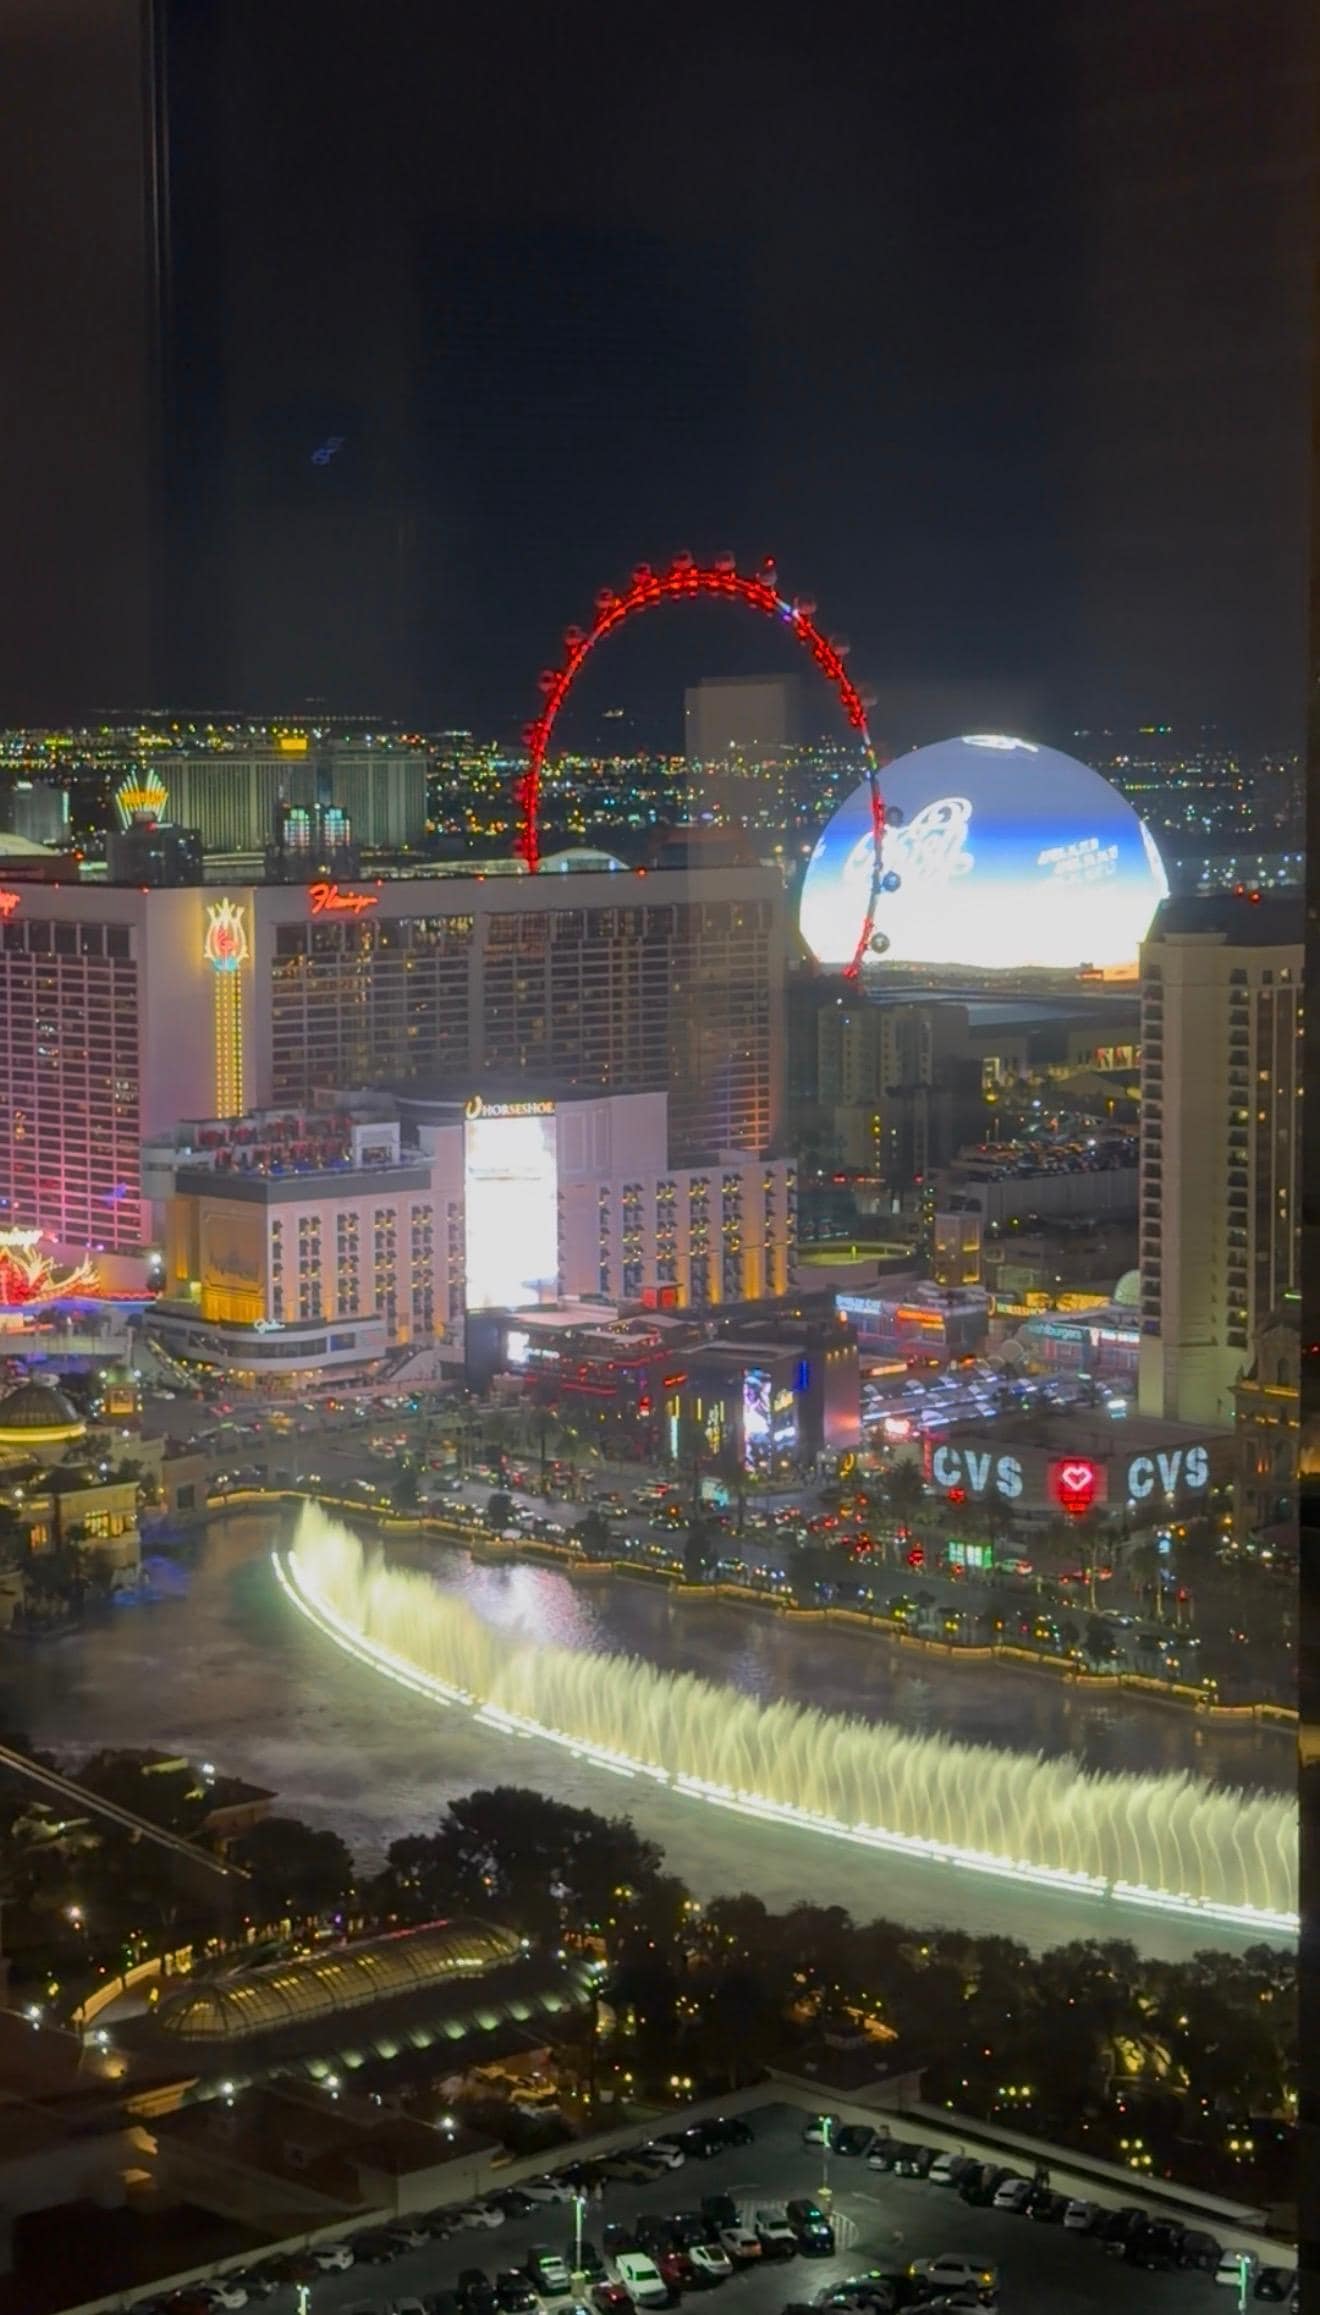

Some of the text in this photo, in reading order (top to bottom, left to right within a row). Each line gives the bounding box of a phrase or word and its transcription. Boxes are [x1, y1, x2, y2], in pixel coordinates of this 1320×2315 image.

[309, 883, 378, 914] Flamingo
[481, 1101, 556, 1117] HORSESHOE
[933, 1445, 1023, 1498] CVS
[1127, 1445, 1209, 1498] CVS
